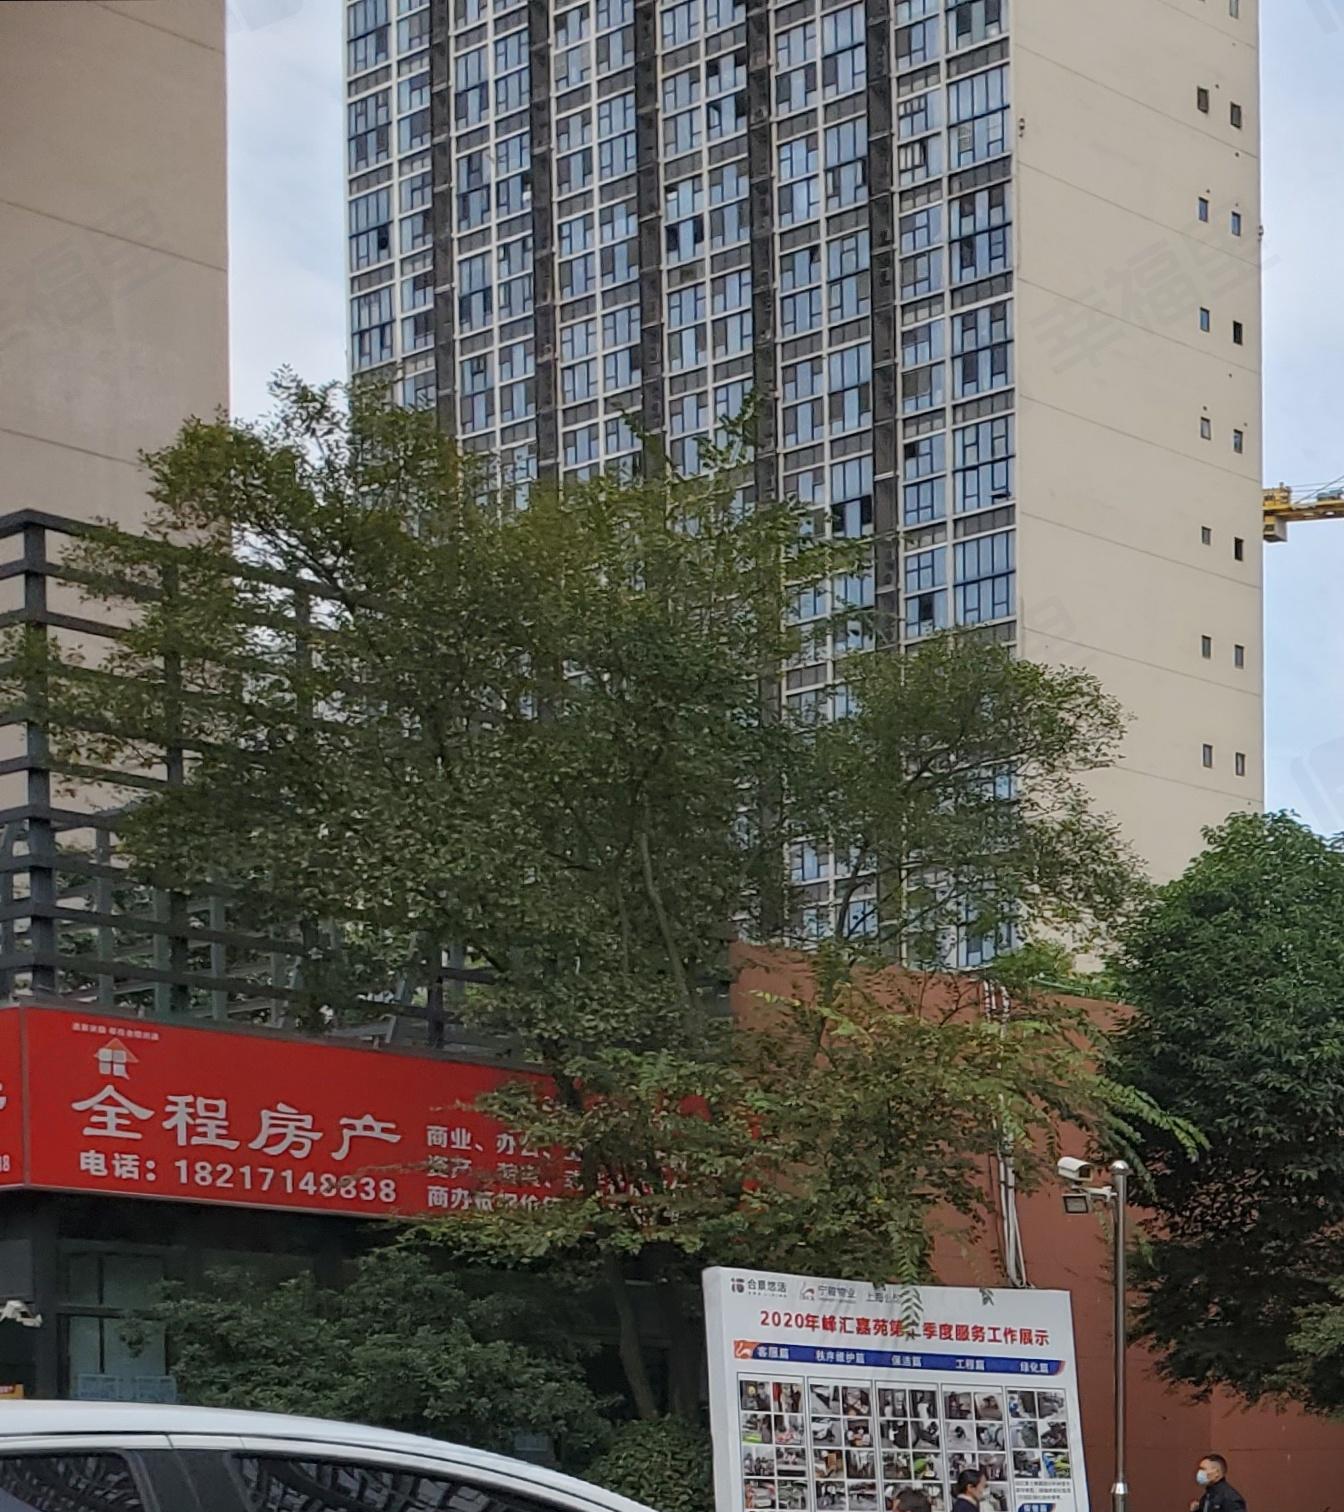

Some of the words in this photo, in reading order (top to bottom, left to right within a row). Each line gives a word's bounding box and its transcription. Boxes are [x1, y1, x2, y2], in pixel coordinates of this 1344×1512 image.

[70, 1083, 402, 1162] 全程房产
[757, 1345, 790, 1361] 客服篇
[815, 1348, 866, 1366] 秩序维护篇
[955, 1357, 986, 1372] 工程篇
